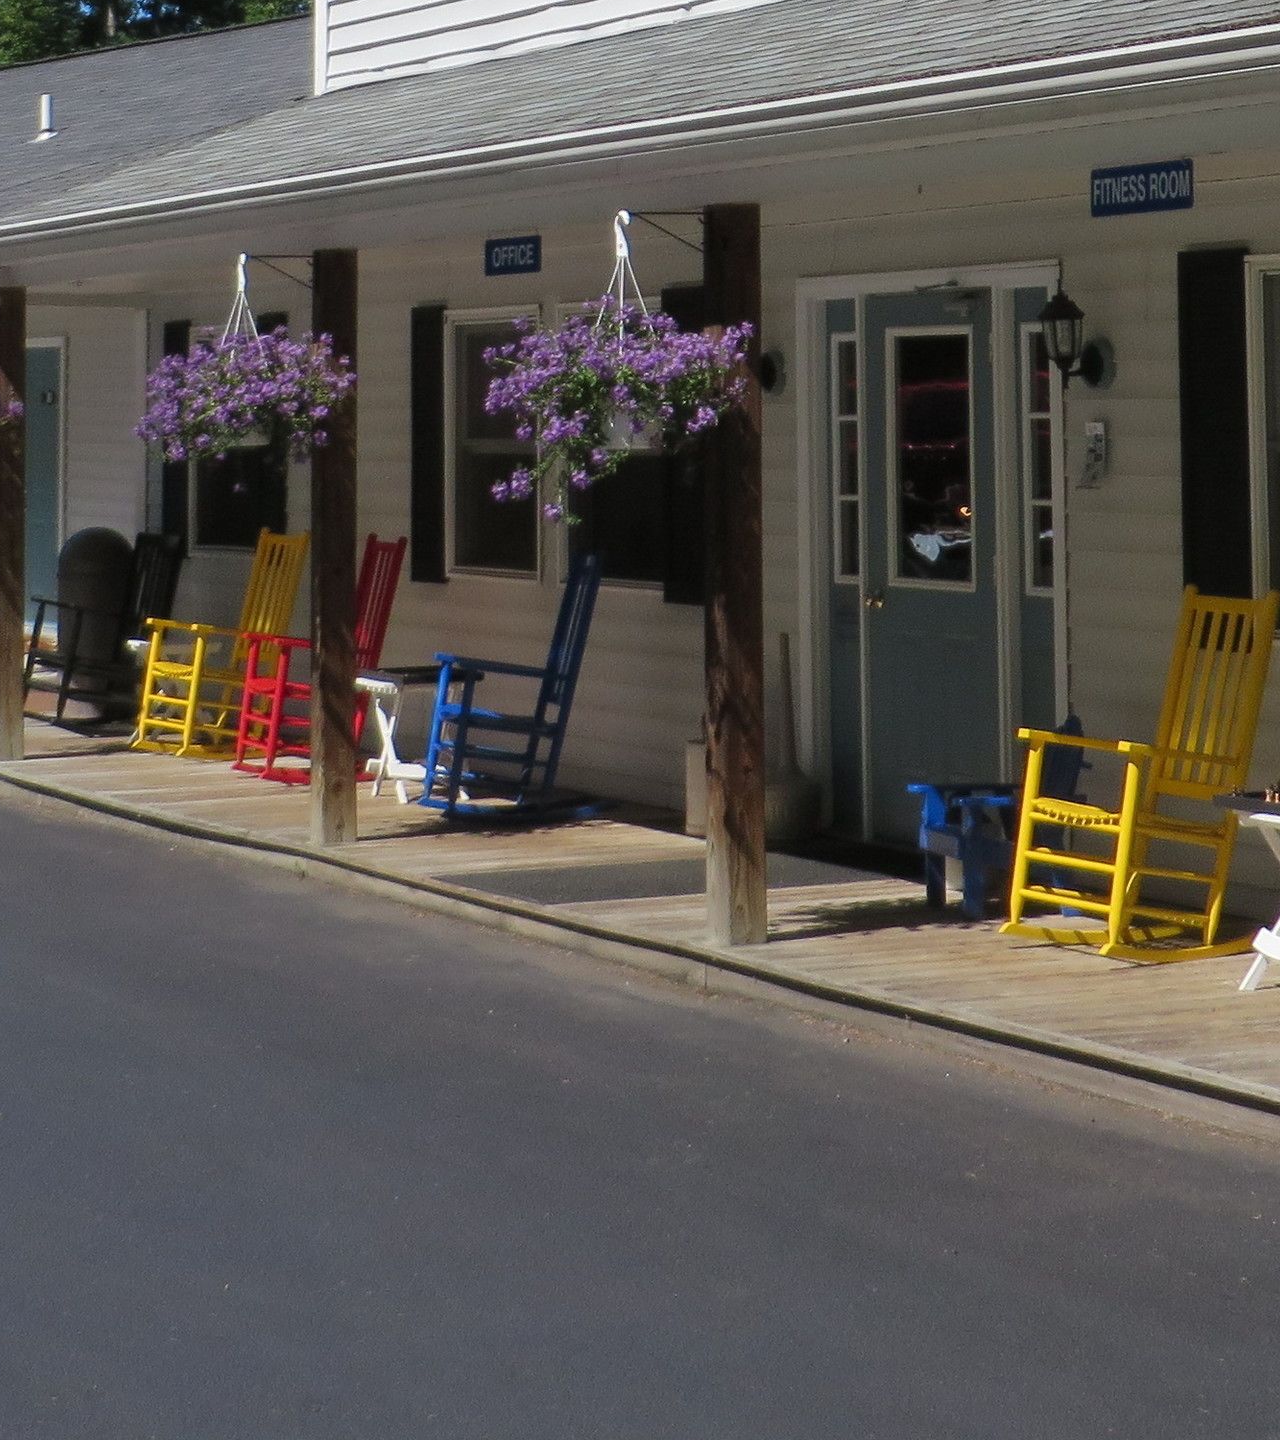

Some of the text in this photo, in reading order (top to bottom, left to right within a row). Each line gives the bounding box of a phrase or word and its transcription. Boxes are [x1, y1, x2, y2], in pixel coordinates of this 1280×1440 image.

[1093, 169, 1190, 205] FITNESS ROOM
[492, 244, 534, 268] OFFICE
